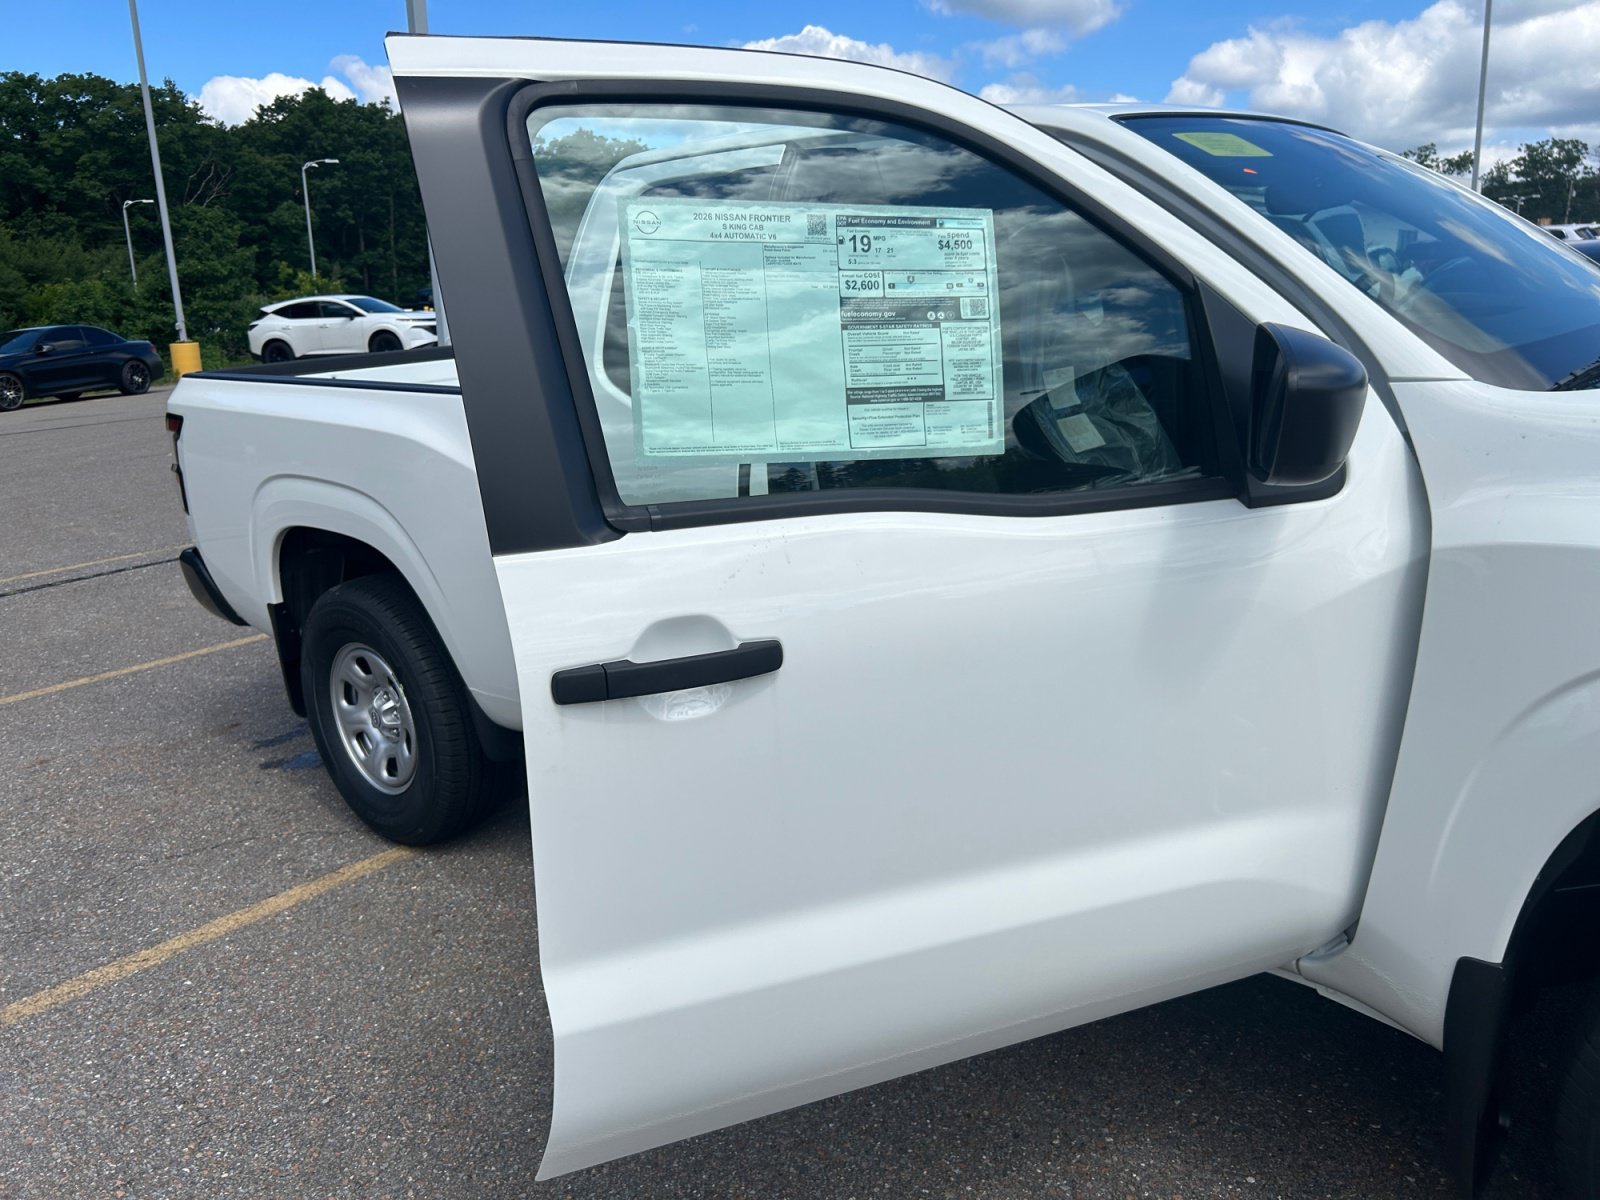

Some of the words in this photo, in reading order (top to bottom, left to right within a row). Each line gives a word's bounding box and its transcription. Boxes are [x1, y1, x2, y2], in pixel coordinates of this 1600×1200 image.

[693, 212, 713, 221] 2026
[714, 213, 747, 222] NISSAN
[749, 214, 791, 223] FRONTIER
[848, 234, 872, 253] 19
[938, 240, 972, 251] $4,500
[845, 280, 880, 291] $2,600
